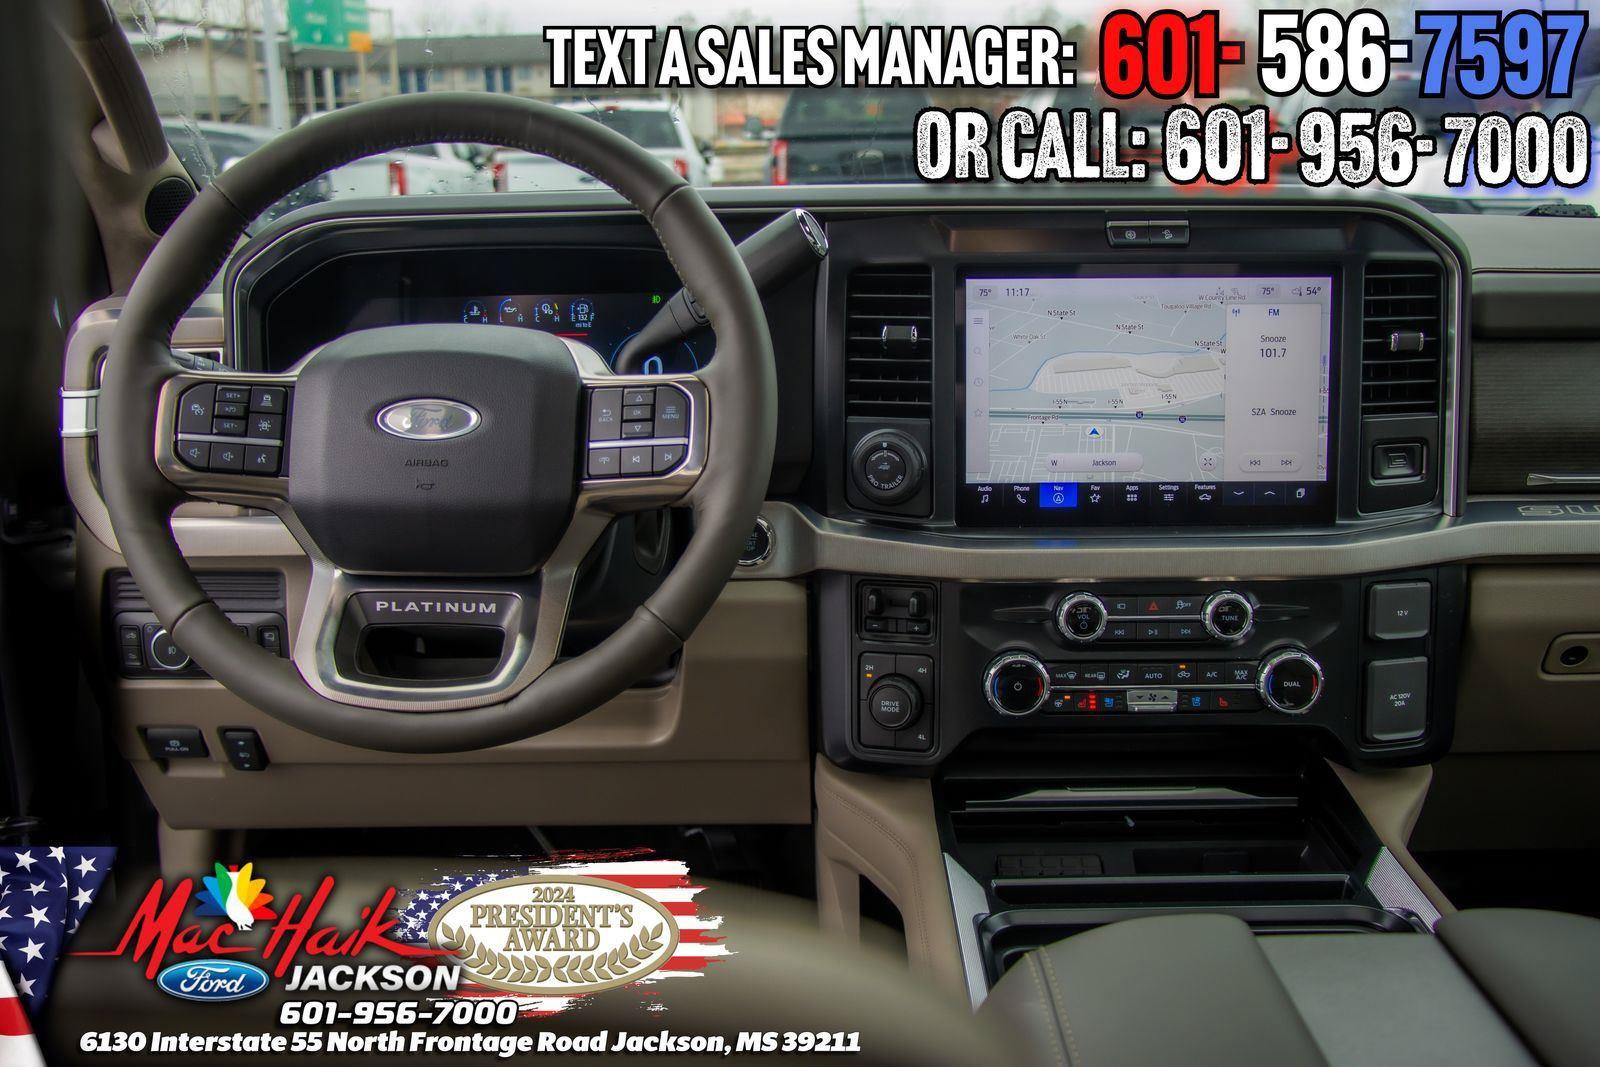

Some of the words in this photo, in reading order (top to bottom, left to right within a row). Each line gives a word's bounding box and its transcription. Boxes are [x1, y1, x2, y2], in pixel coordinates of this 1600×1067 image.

[1006, 288, 1030, 297] 11:17
[1268, 308, 1280, 317] FM
[1260, 335, 1287, 343] Snooze
[1260, 348, 1287, 358] 101.7
[1251, 408, 1266, 416] SZA
[1270, 408, 1297, 416] Snooze
[404, 458, 449, 468] AIRBAG
[1092, 459, 1117, 467] Jackson
[867, 474, 879, 487] PRO
[881, 474, 904, 490] TRAILER
[1125, 484, 1139, 492] Apps
[1158, 484, 1179, 492] Settings
[375, 601, 497, 613] PLATINUM
